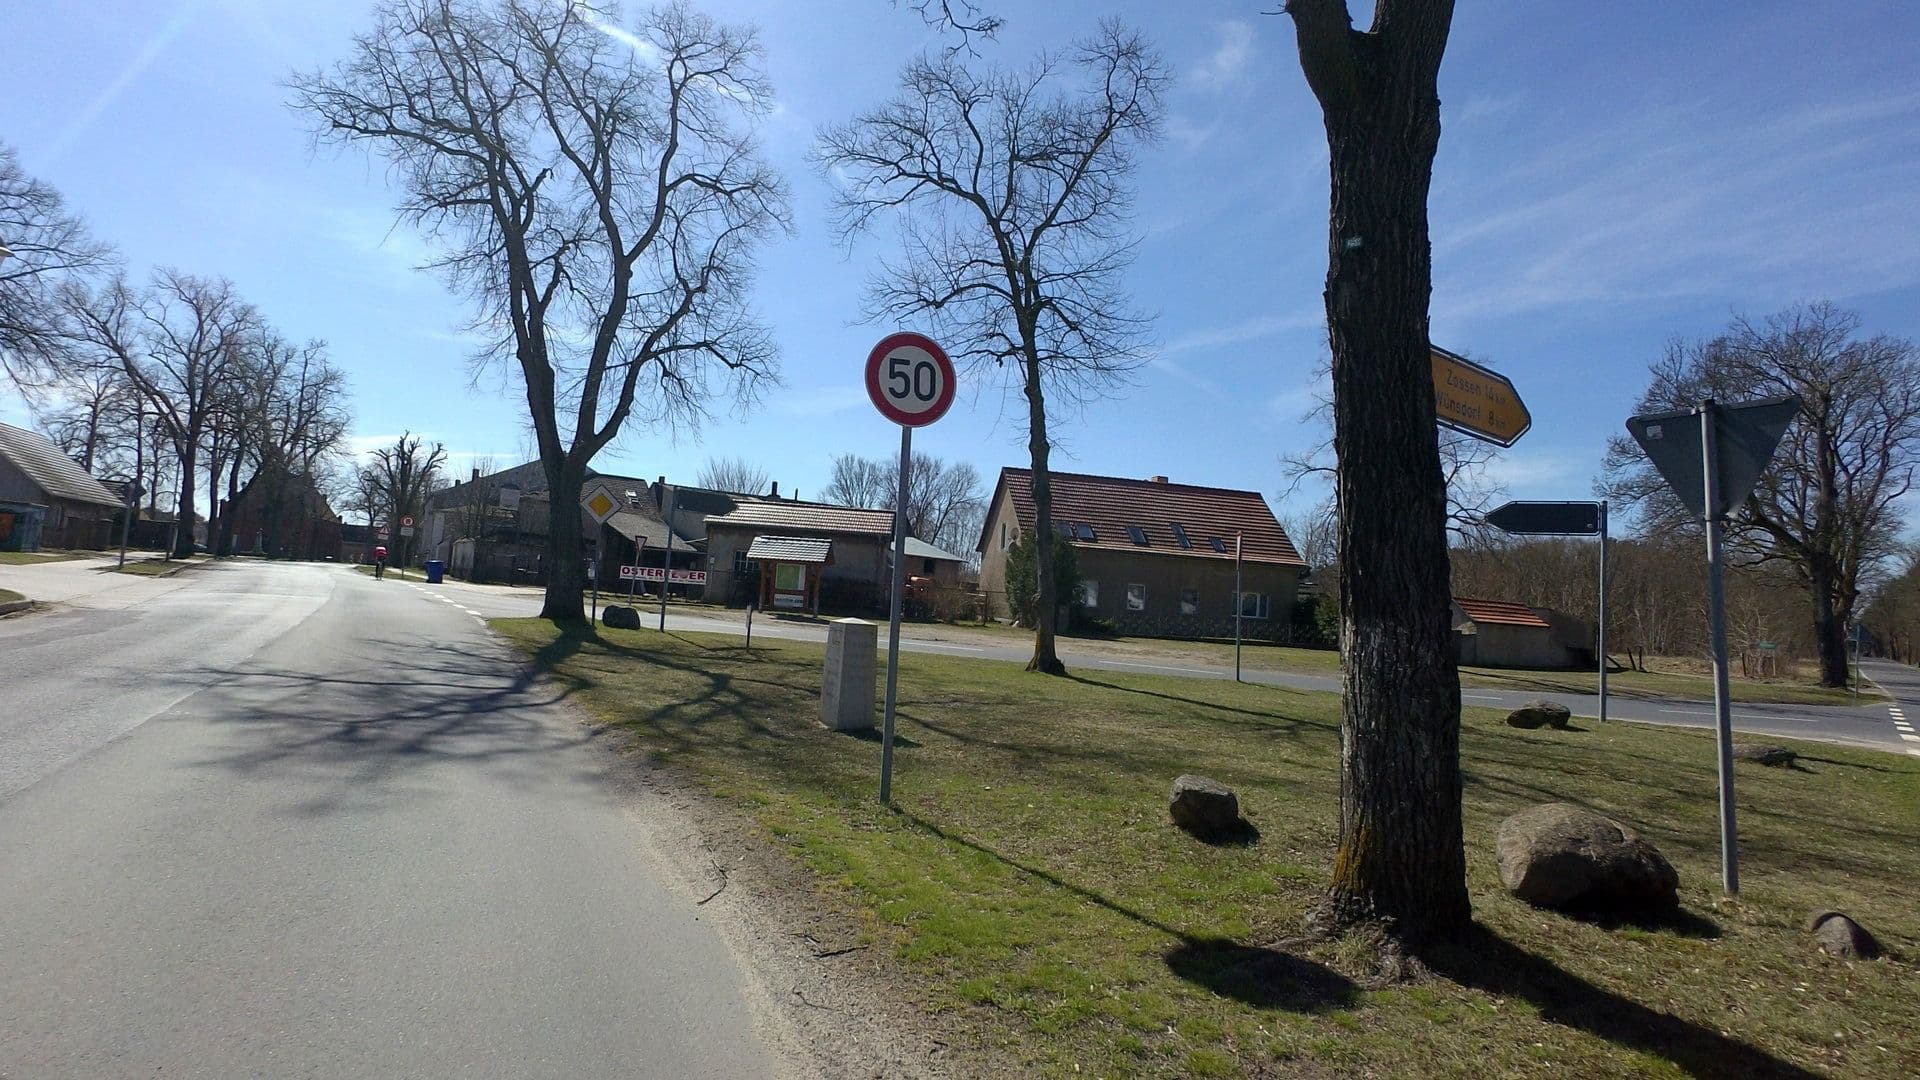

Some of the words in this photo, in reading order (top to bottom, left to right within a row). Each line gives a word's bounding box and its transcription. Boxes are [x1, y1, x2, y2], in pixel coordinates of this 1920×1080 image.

[888, 357, 937, 402] 50
[1446, 368, 1481, 396] Zossen
[1488, 410, 1495, 427] 8
